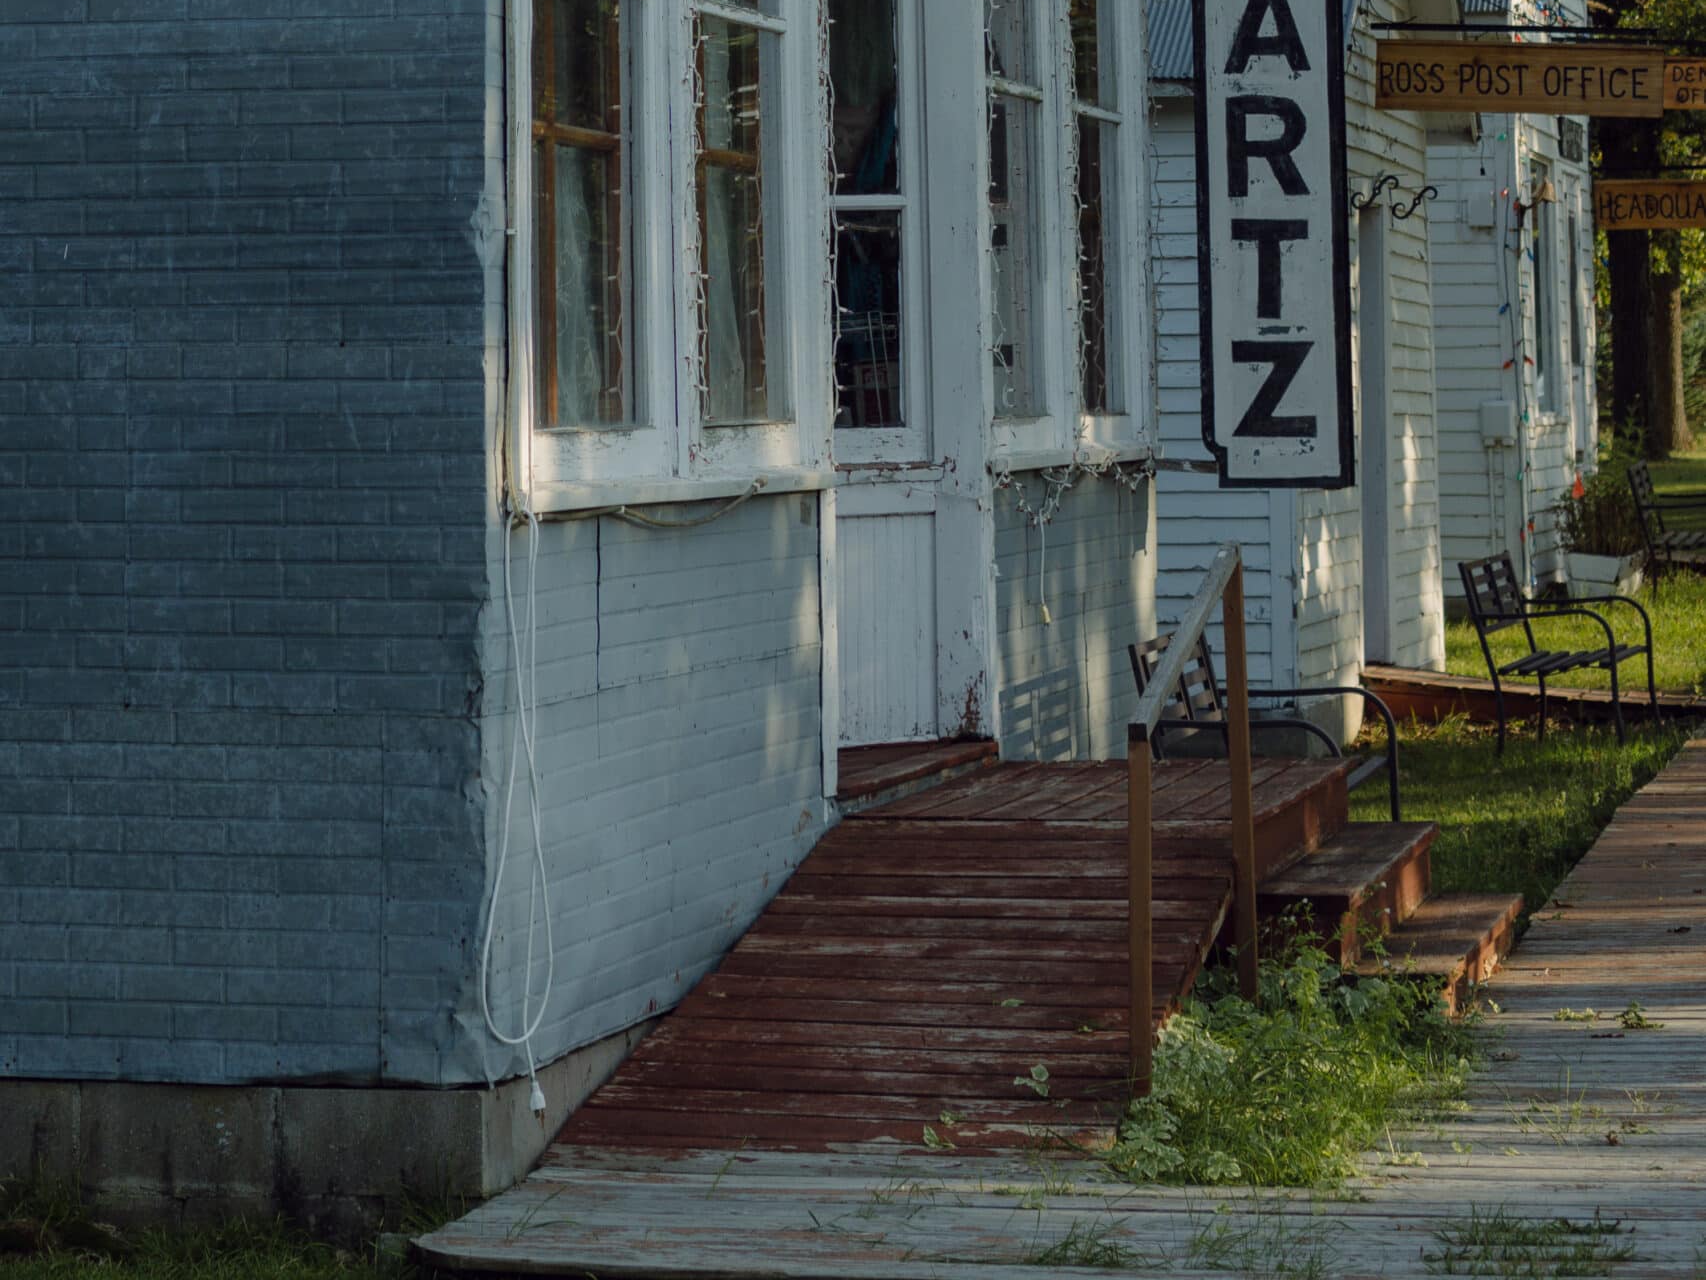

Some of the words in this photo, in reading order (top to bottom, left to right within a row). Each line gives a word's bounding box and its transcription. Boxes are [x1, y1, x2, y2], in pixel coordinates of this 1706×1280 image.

[1379, 61, 1445, 94] ROSS
[1458, 64, 1529, 97] POST
[1543, 66, 1650, 101] OFFICE
[1676, 87, 1706, 105] OF
